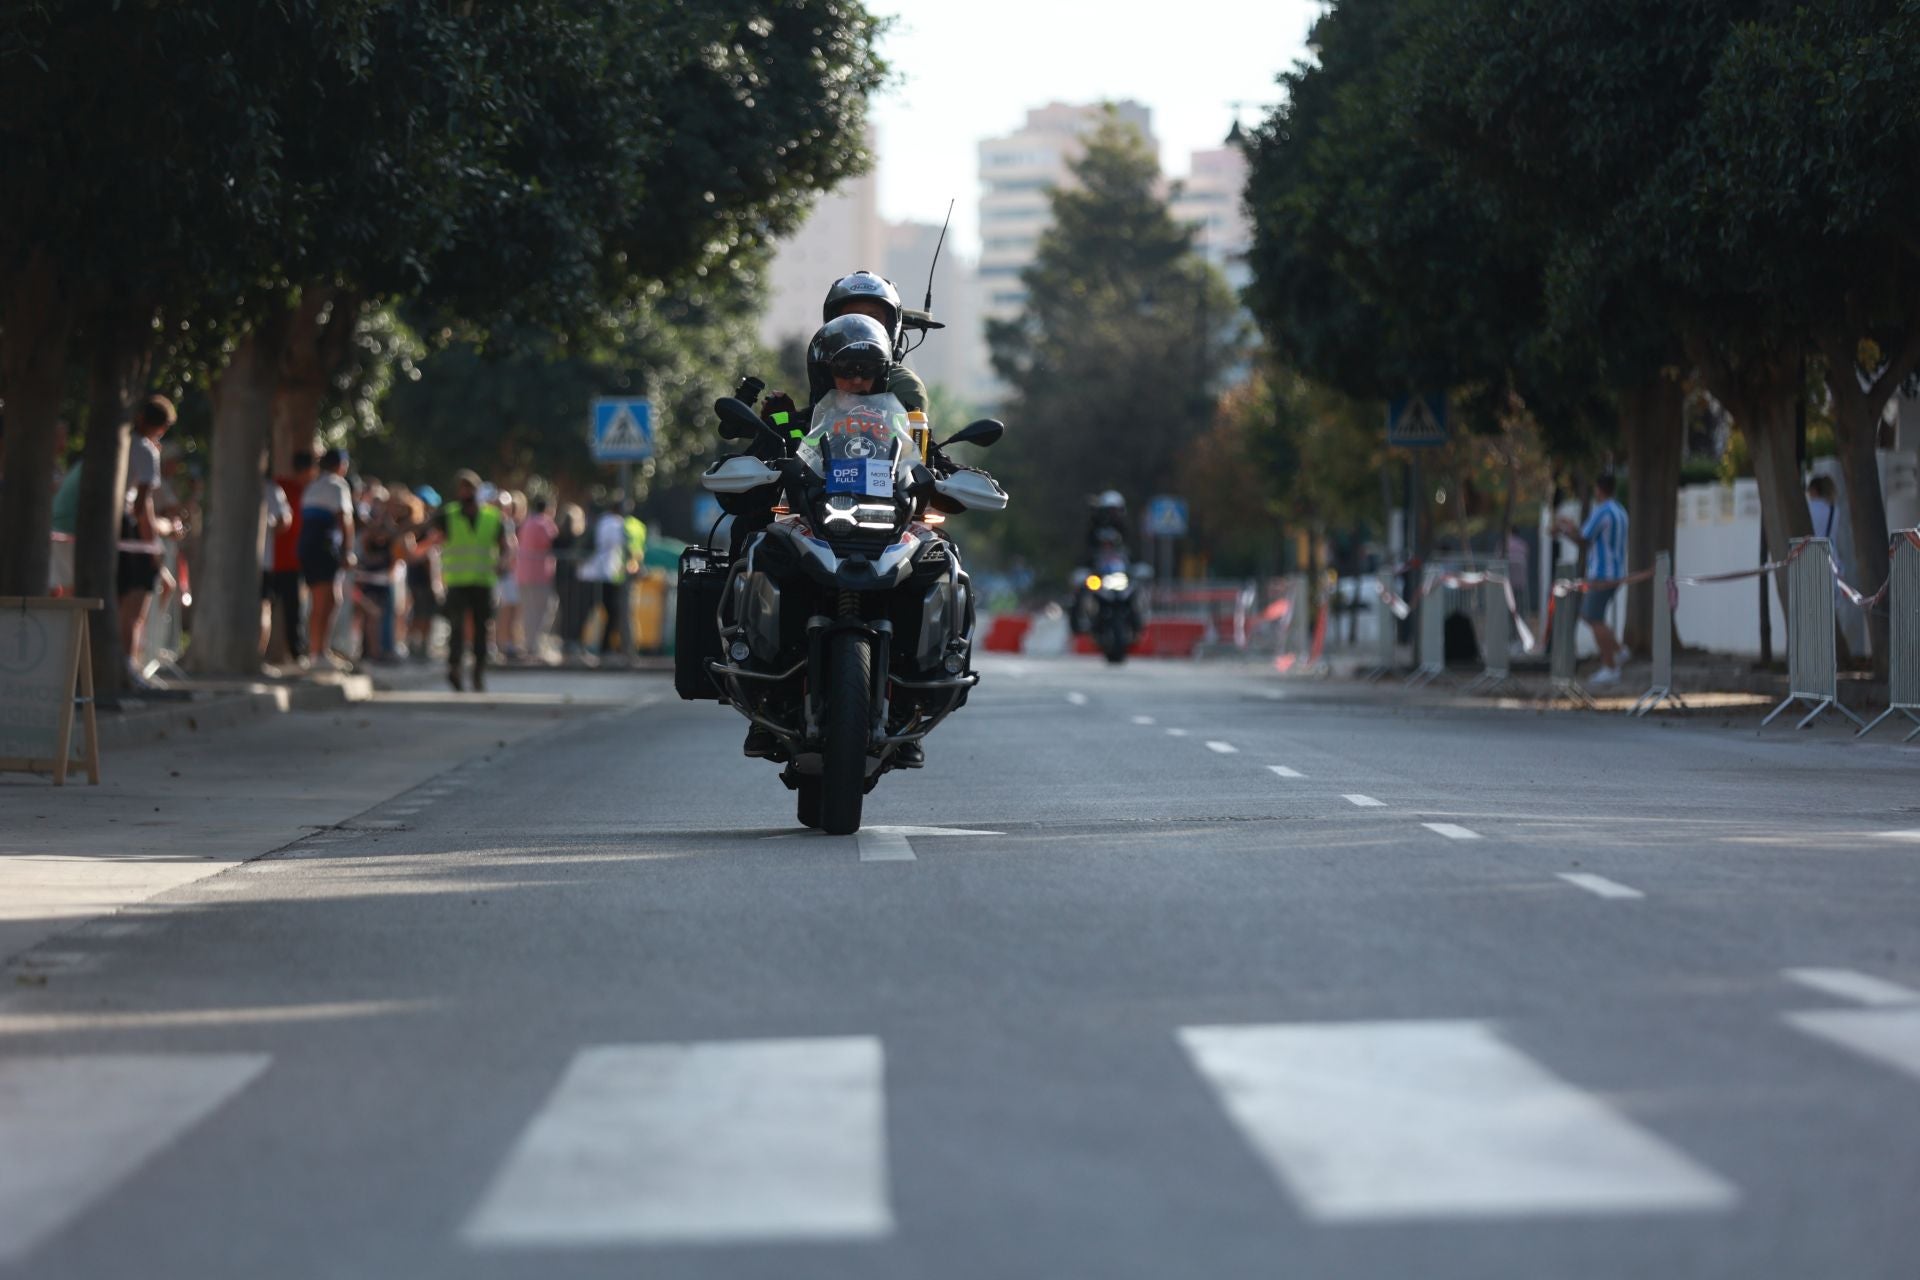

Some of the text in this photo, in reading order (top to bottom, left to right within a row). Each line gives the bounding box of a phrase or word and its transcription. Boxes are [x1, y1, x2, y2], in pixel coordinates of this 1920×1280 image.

[832, 415, 889, 442] rtve
[833, 468, 859, 478] OPS
[872, 479, 886, 487] 23
